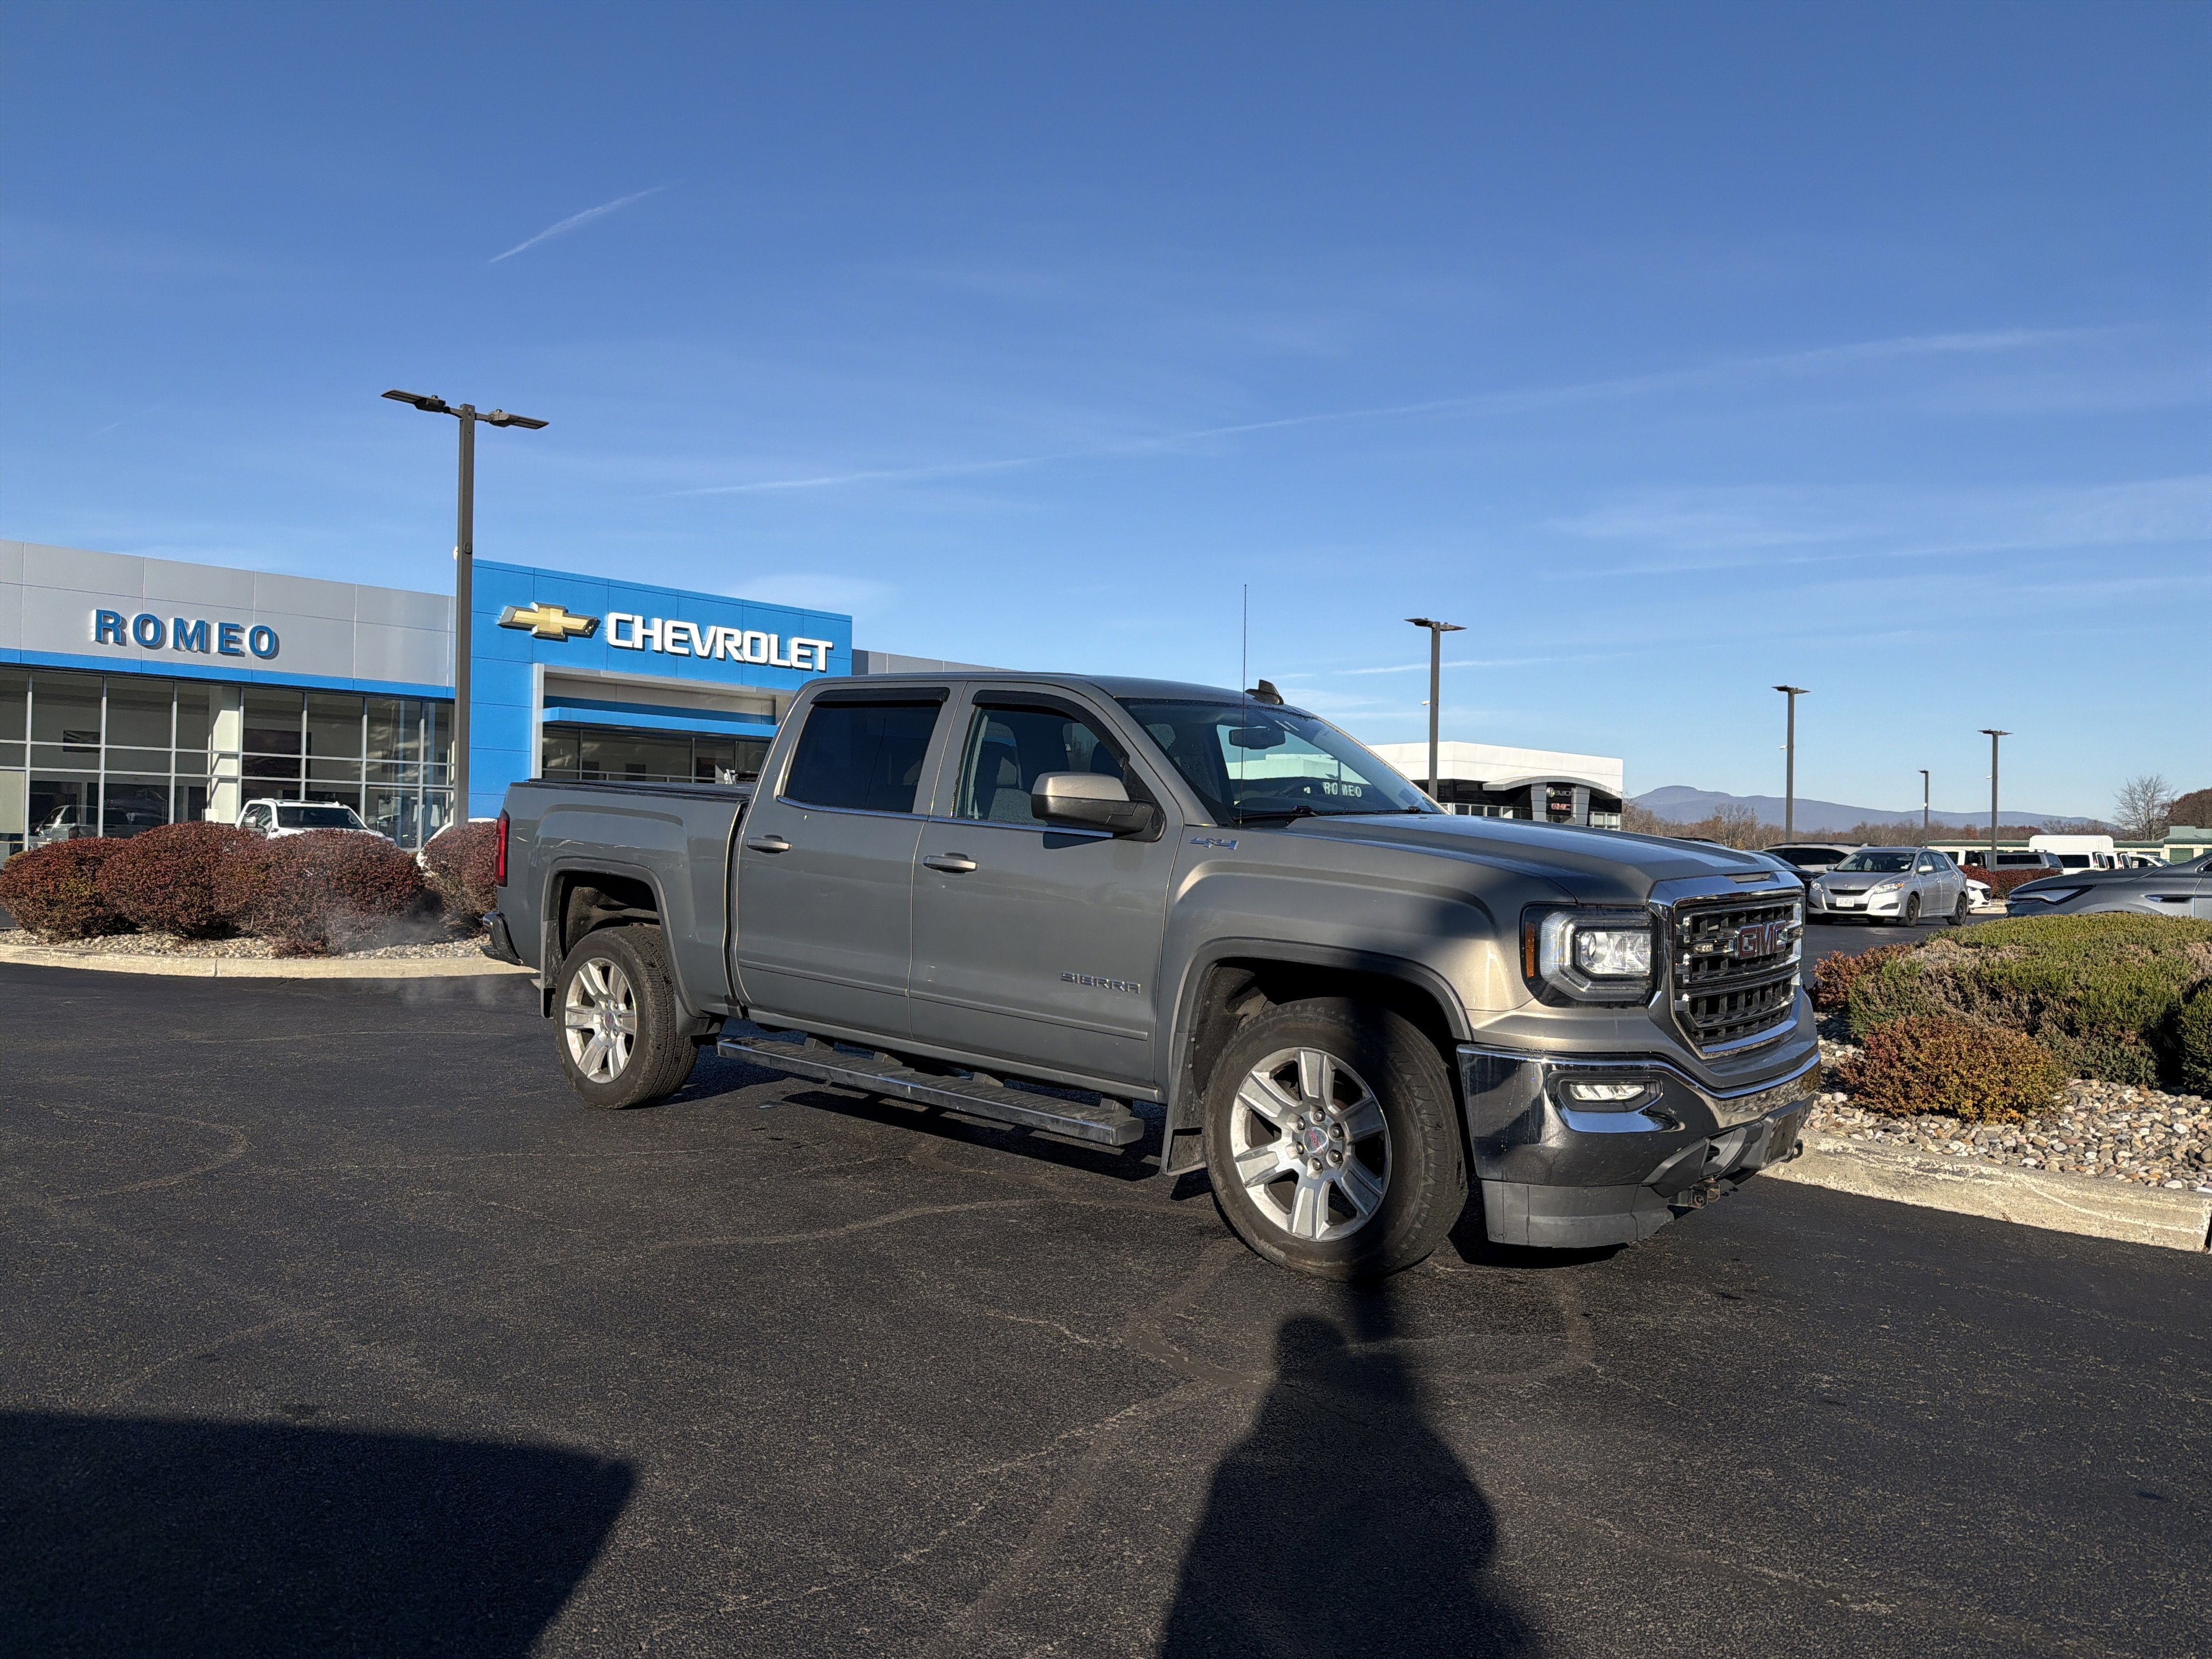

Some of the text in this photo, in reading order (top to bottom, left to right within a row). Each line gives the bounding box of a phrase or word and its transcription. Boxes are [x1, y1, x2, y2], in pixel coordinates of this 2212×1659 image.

[94, 608, 275, 657] ROMEO
[607, 612, 833, 672] CHEVROLET
[1323, 781, 1362, 798] ROMEO
[1551, 803, 1571, 811] GMC
[1737, 919, 1787, 960] GMC
[1060, 972, 1142, 994] SIERRA
